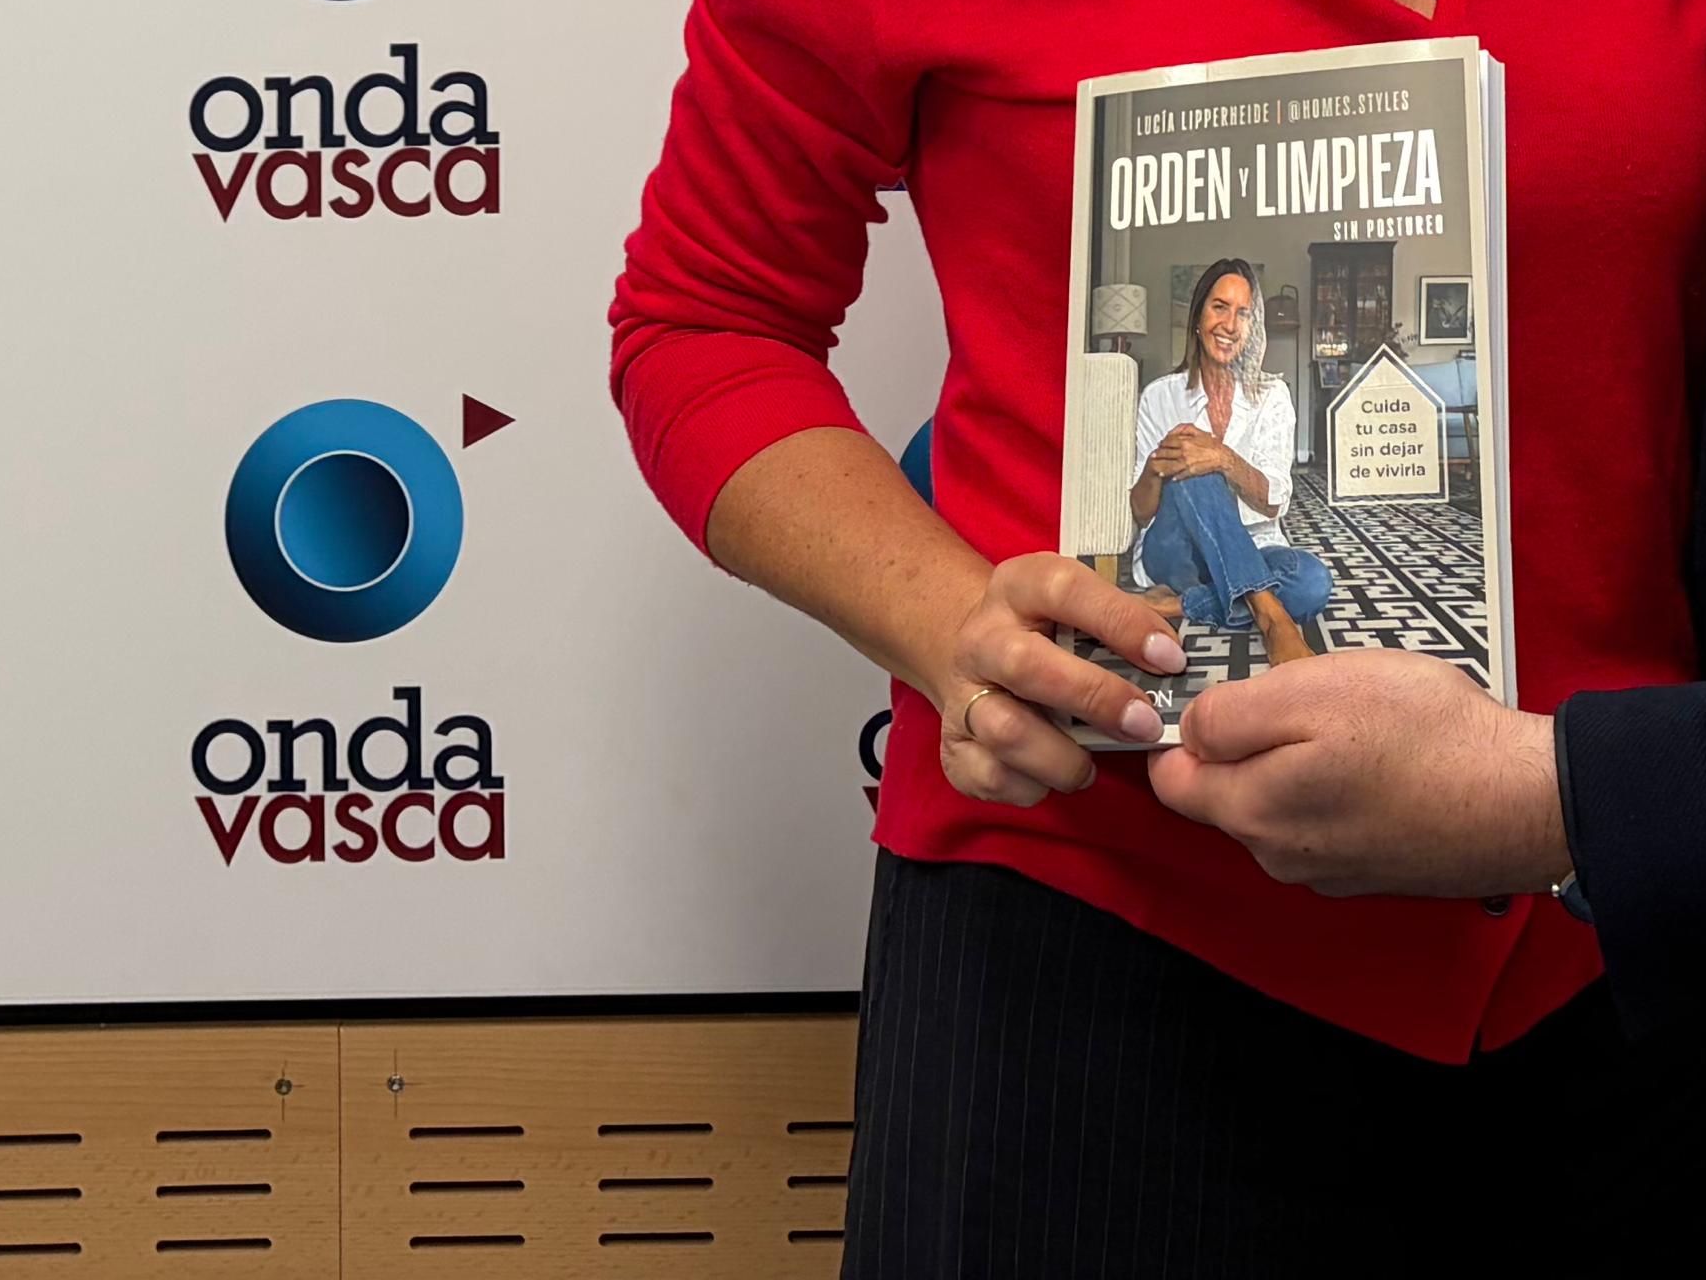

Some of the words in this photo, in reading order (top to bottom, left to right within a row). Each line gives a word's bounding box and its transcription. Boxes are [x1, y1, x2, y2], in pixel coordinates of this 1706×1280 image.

[189, 43, 499, 152] onda
[1136, 109, 1175, 137] LUCÍA
[1180, 102, 1270, 132] LIPPERHEIDE
[1287, 90, 1410, 123] @HOMES.STYLES
[192, 146, 499, 222] vasca
[1109, 146, 1231, 230] ORDEN
[1238, 167, 1249, 197] Y
[1256, 129, 1443, 217] LIMPIEZA
[1333, 220, 1358, 241] SIN
[1366, 214, 1444, 239] POSTUREO
[1356, 423, 1373, 436] tu
[1378, 422, 1417, 435] casa
[1361, 399, 1411, 414] Cuida
[1349, 465, 1371, 479] de
[1376, 463, 1426, 478] vivirla
[1350, 443, 1374, 457] sin
[1379, 442, 1424, 458] dejar
[191, 686, 505, 795] onda
[194, 790, 505, 867] vasca
